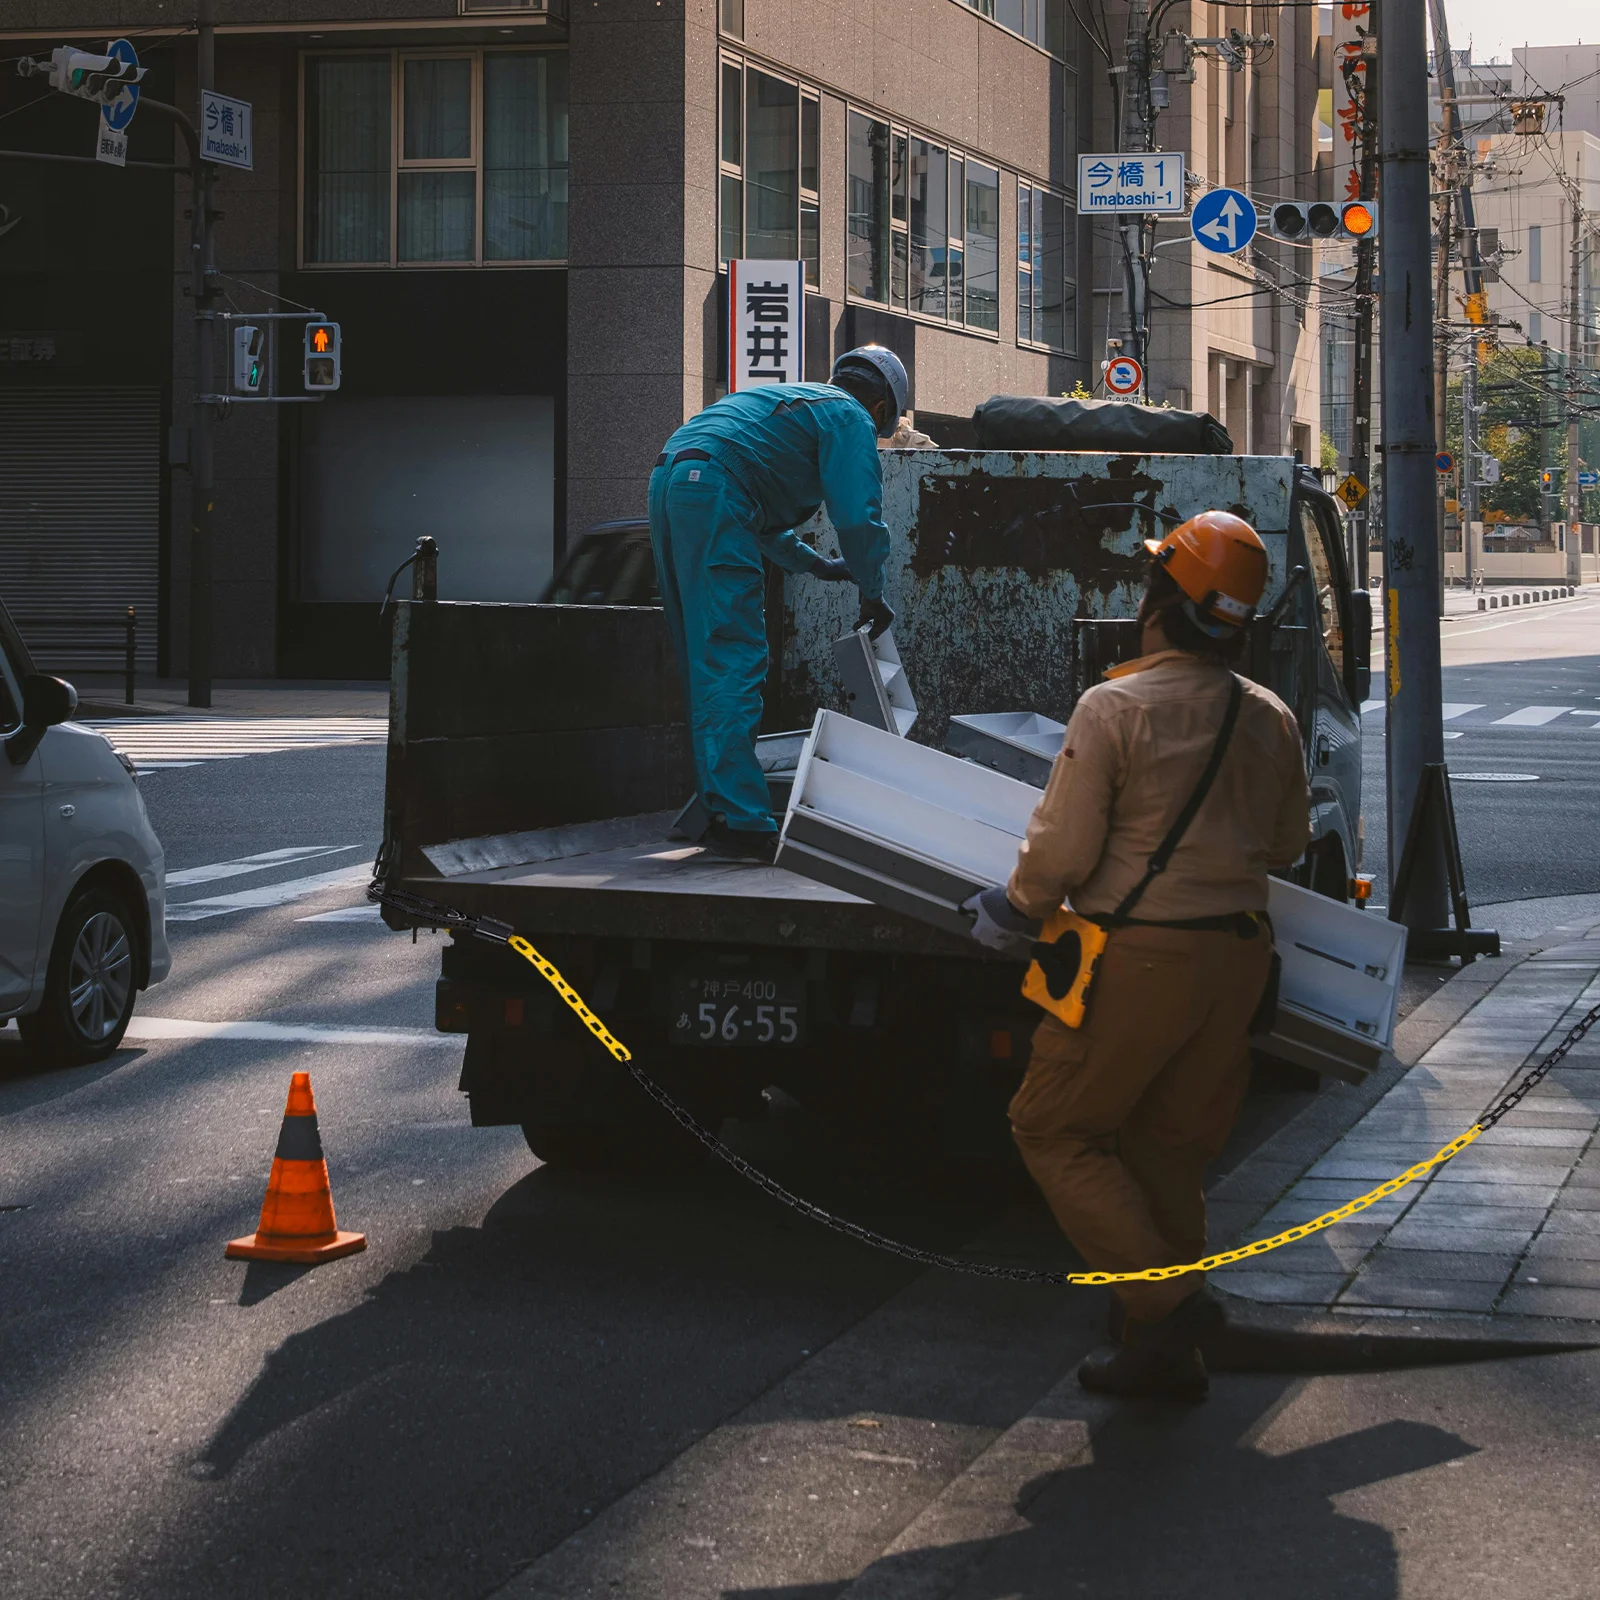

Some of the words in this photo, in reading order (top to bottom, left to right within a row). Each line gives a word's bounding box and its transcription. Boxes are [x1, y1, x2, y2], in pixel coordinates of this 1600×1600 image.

[206, 136, 247, 160] Imabashi-1
[1090, 191, 1172, 206] Imabashi-1
[676, 1012, 692, 1029] あ
[699, 1003, 798, 1043] 56-55
